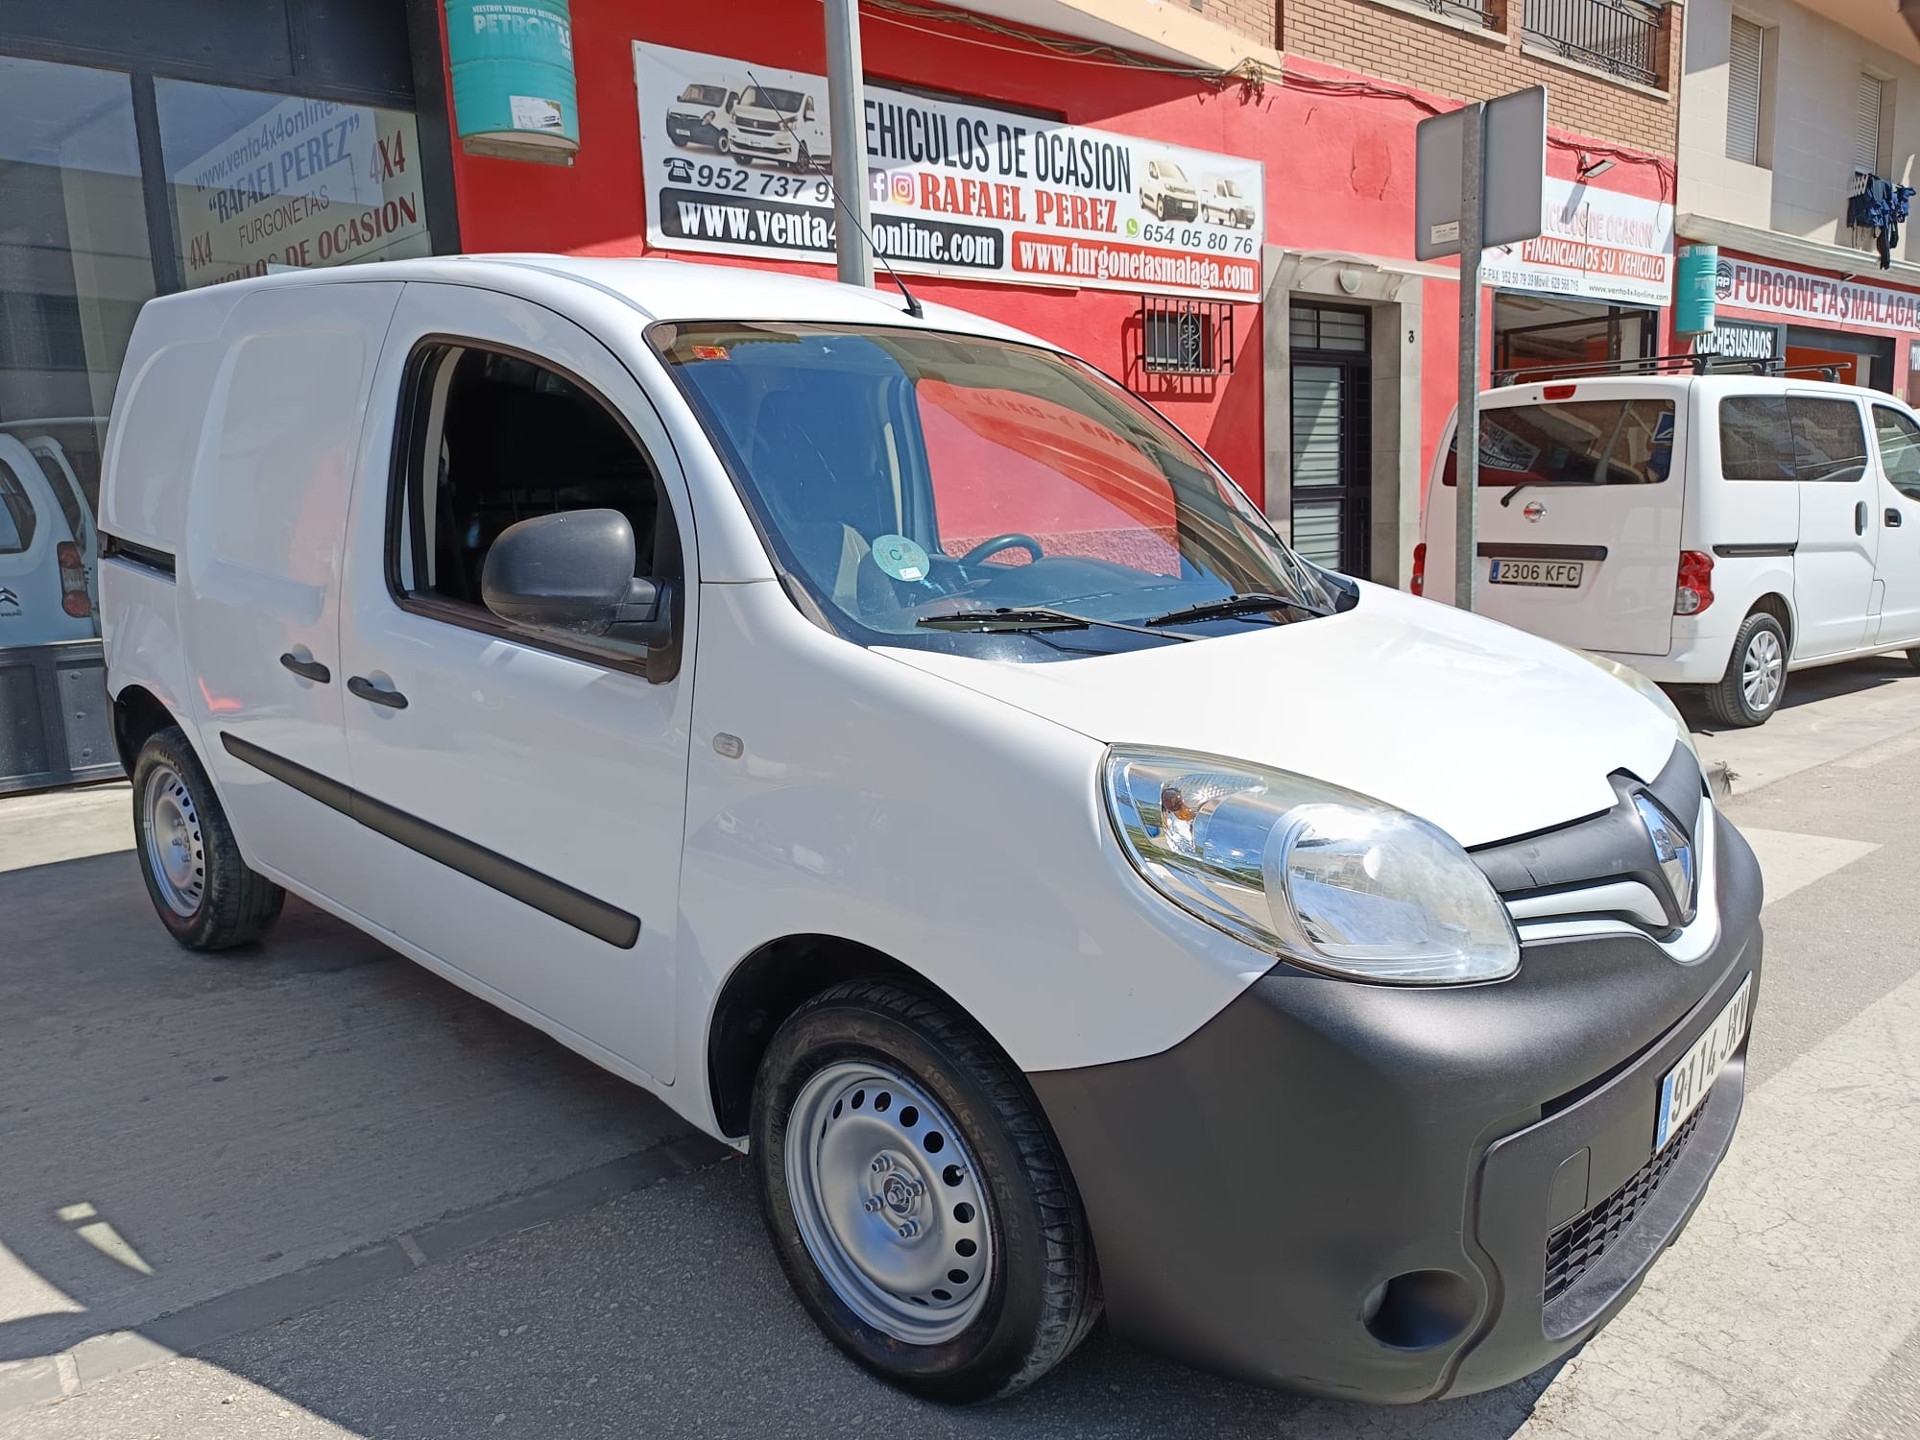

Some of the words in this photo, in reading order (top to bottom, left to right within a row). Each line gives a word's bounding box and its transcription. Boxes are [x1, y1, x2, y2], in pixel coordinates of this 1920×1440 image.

[369, 130, 406, 185] 4X4
[865, 100, 990, 173] EHICULOS
[996, 123, 1028, 179] DE
[1035, 131, 1132, 194] OCASION
[697, 165, 749, 193] 952
[760, 173, 807, 200] 737
[919, 171, 1026, 223] RAFAEL
[1035, 189, 1118, 234] PEREZ
[239, 184, 330, 248] FURGONETAS
[285, 239, 314, 267] DE
[318, 192, 417, 260] OCASION
[1143, 223, 1175, 245] 654
[1181, 231, 1202, 248] 05
[1207, 232, 1228, 251] 80
[1234, 236, 1253, 254] 76
[1607, 215, 1653, 250] OCASION
[1019, 240, 1254, 291] www.furgonetasmalaga.com
[1524, 238, 1600, 271] FINANCIAMOS
[1600, 246, 1617, 273] SU
[1618, 252, 1665, 281] VEHICULO
[1501, 563, 1540, 580] 2306
[1545, 565, 1577, 582] KFC
[1671, 1028, 1718, 1123] 9114
